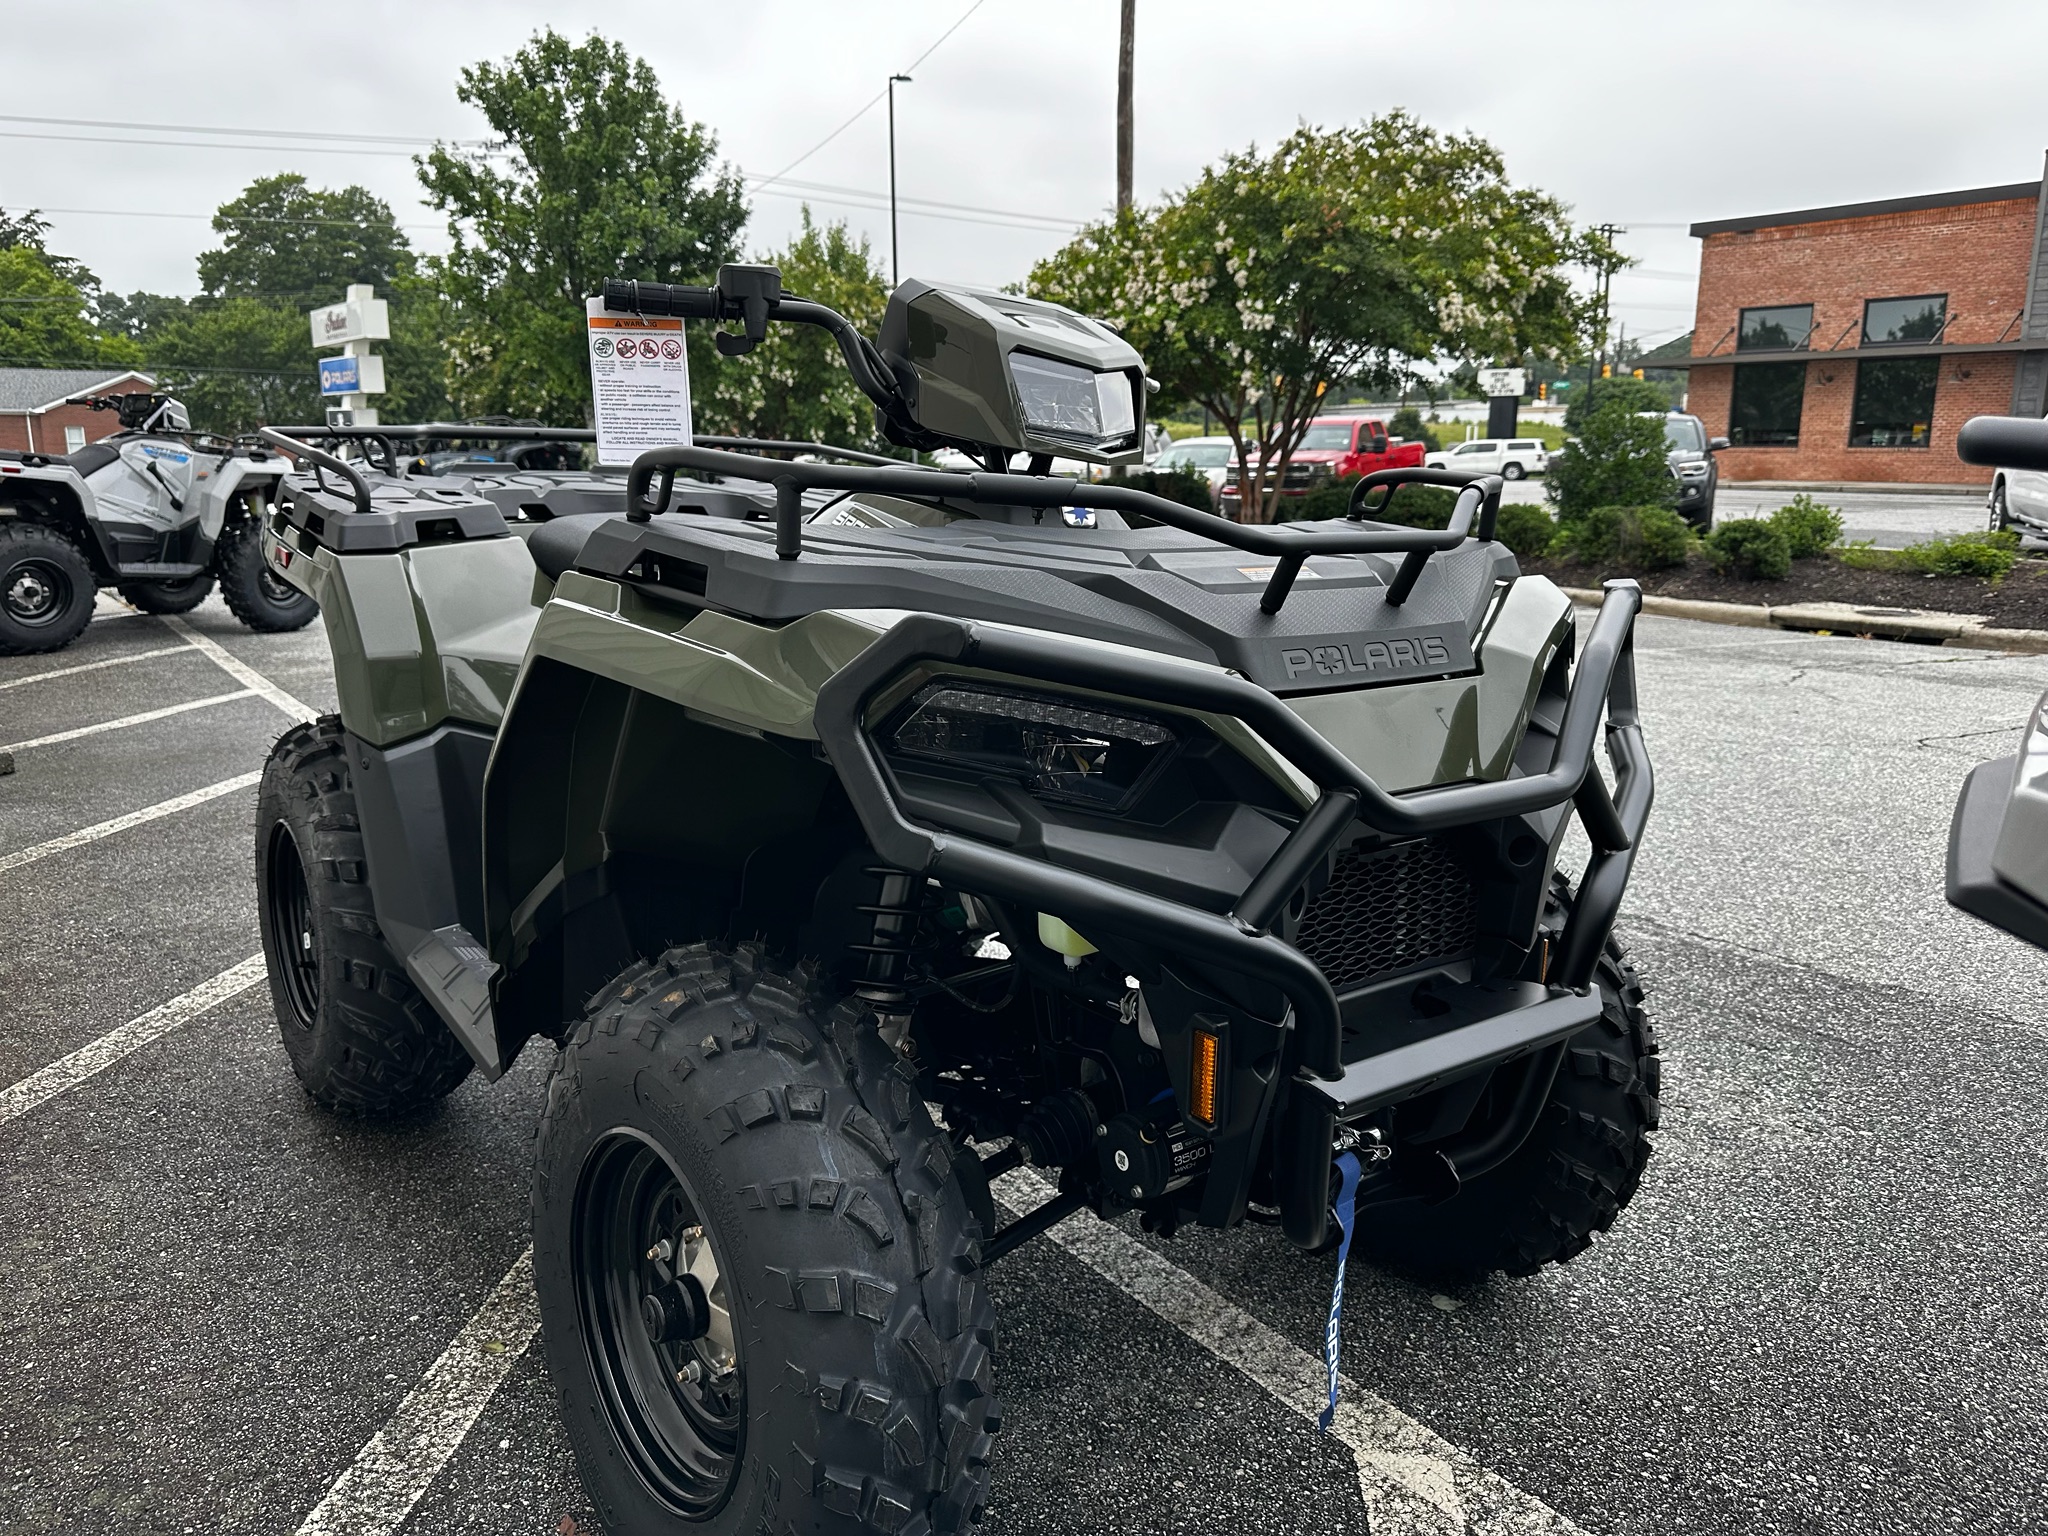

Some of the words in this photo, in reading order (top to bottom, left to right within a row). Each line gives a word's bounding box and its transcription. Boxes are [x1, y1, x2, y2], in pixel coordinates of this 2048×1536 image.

[623, 320, 658, 328] WARNNG
[1281, 636, 1450, 679] POLARIS
[1174, 1146, 1206, 1167] 3500
